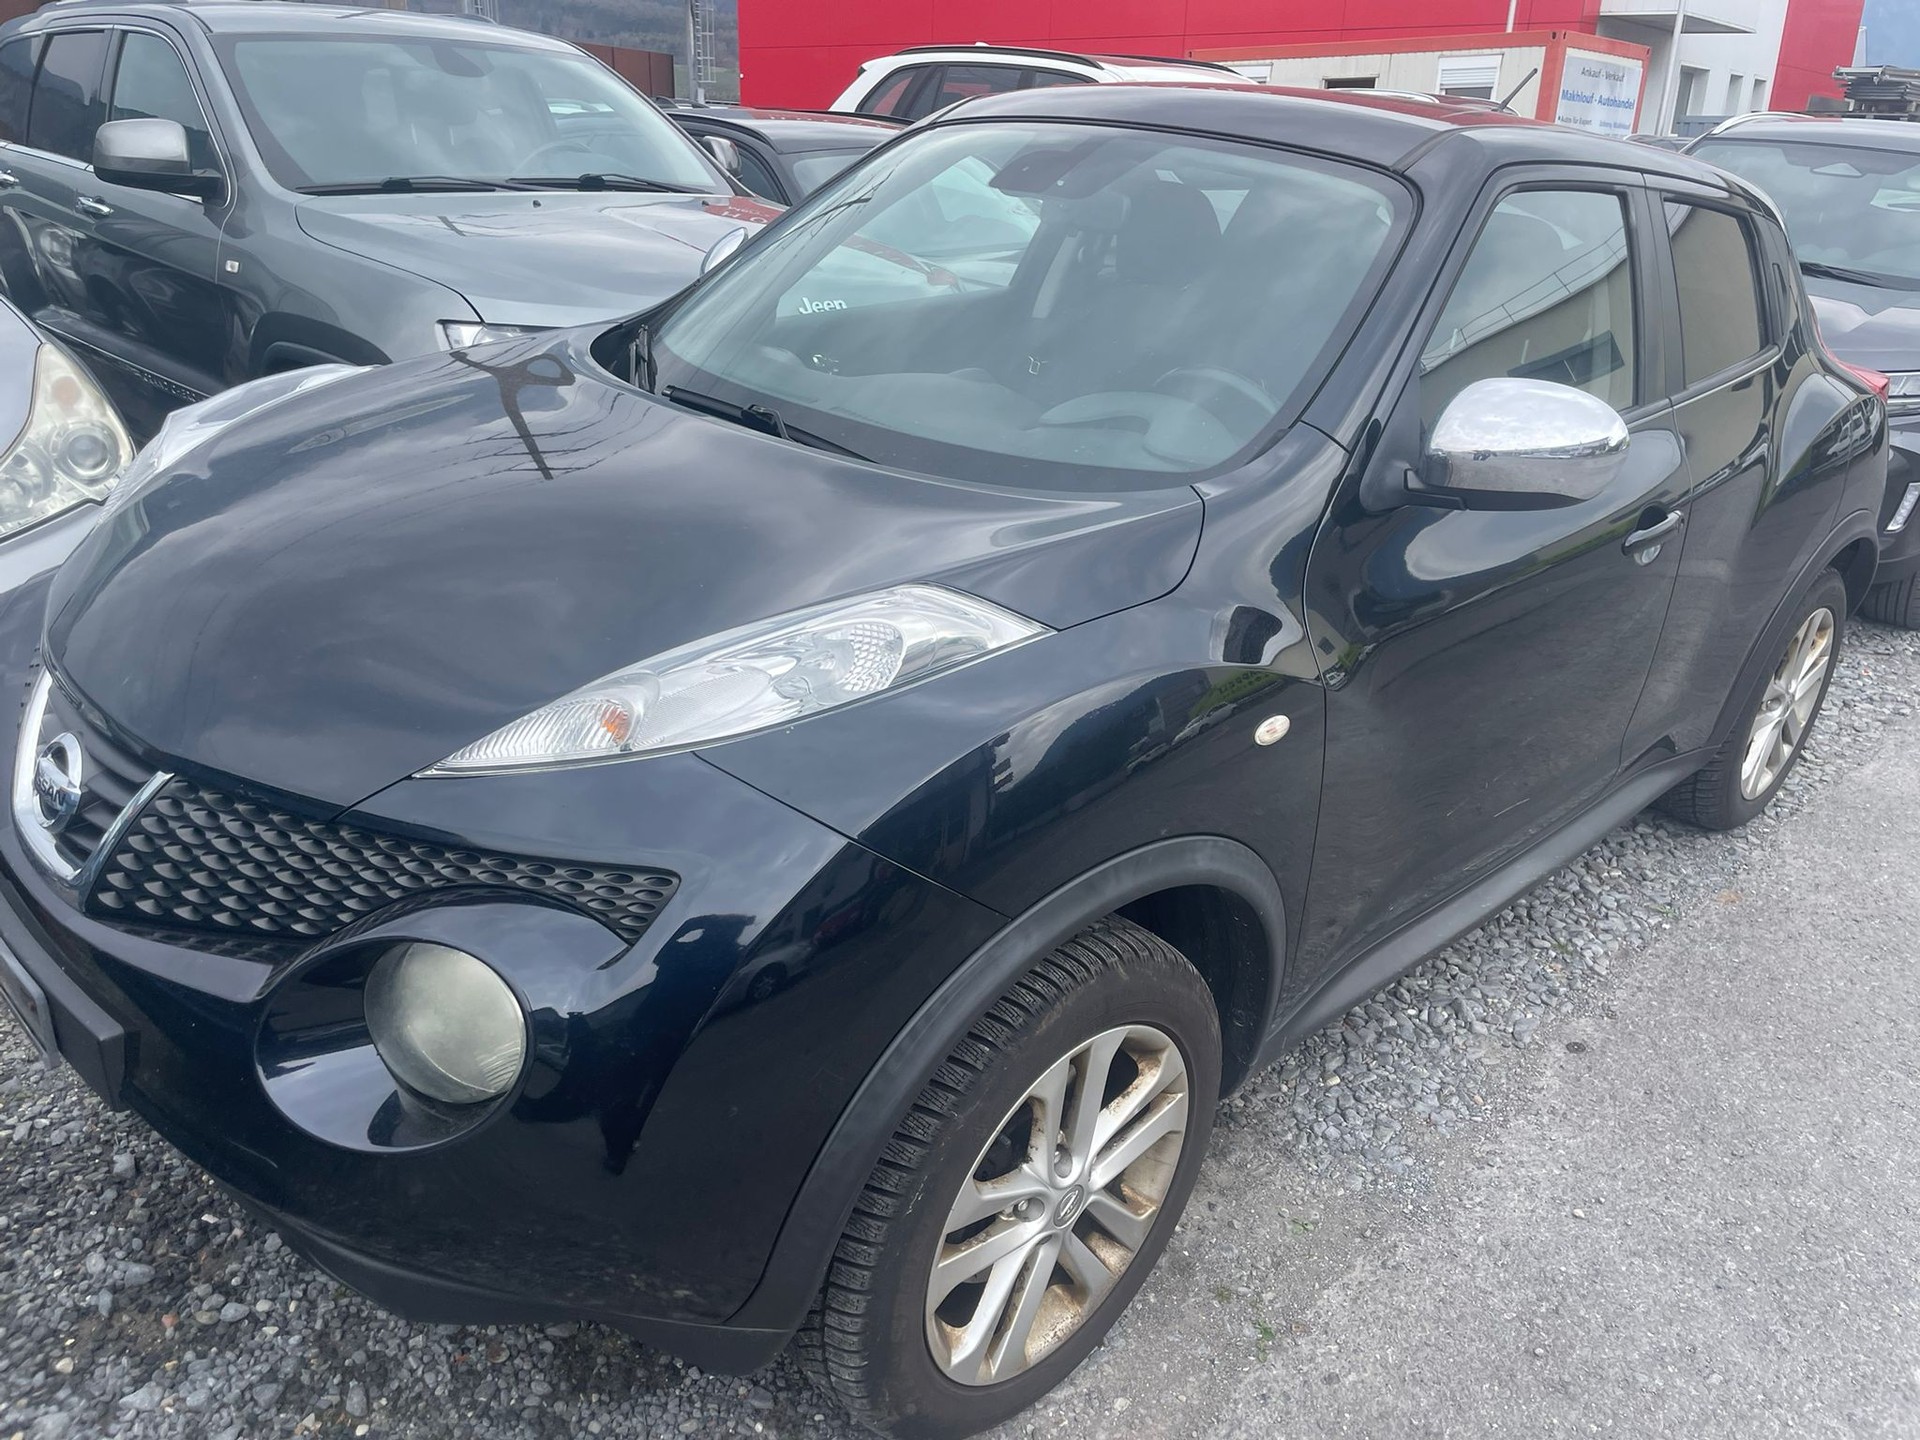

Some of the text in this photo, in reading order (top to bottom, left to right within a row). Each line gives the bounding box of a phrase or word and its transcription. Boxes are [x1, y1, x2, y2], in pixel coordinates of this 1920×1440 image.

[1581, 67, 1602, 78] Ankauf
[1605, 70, 1625, 82] Verkauf
[1561, 89, 1594, 104] Makhlouf
[1597, 94, 1635, 110] Autohandel
